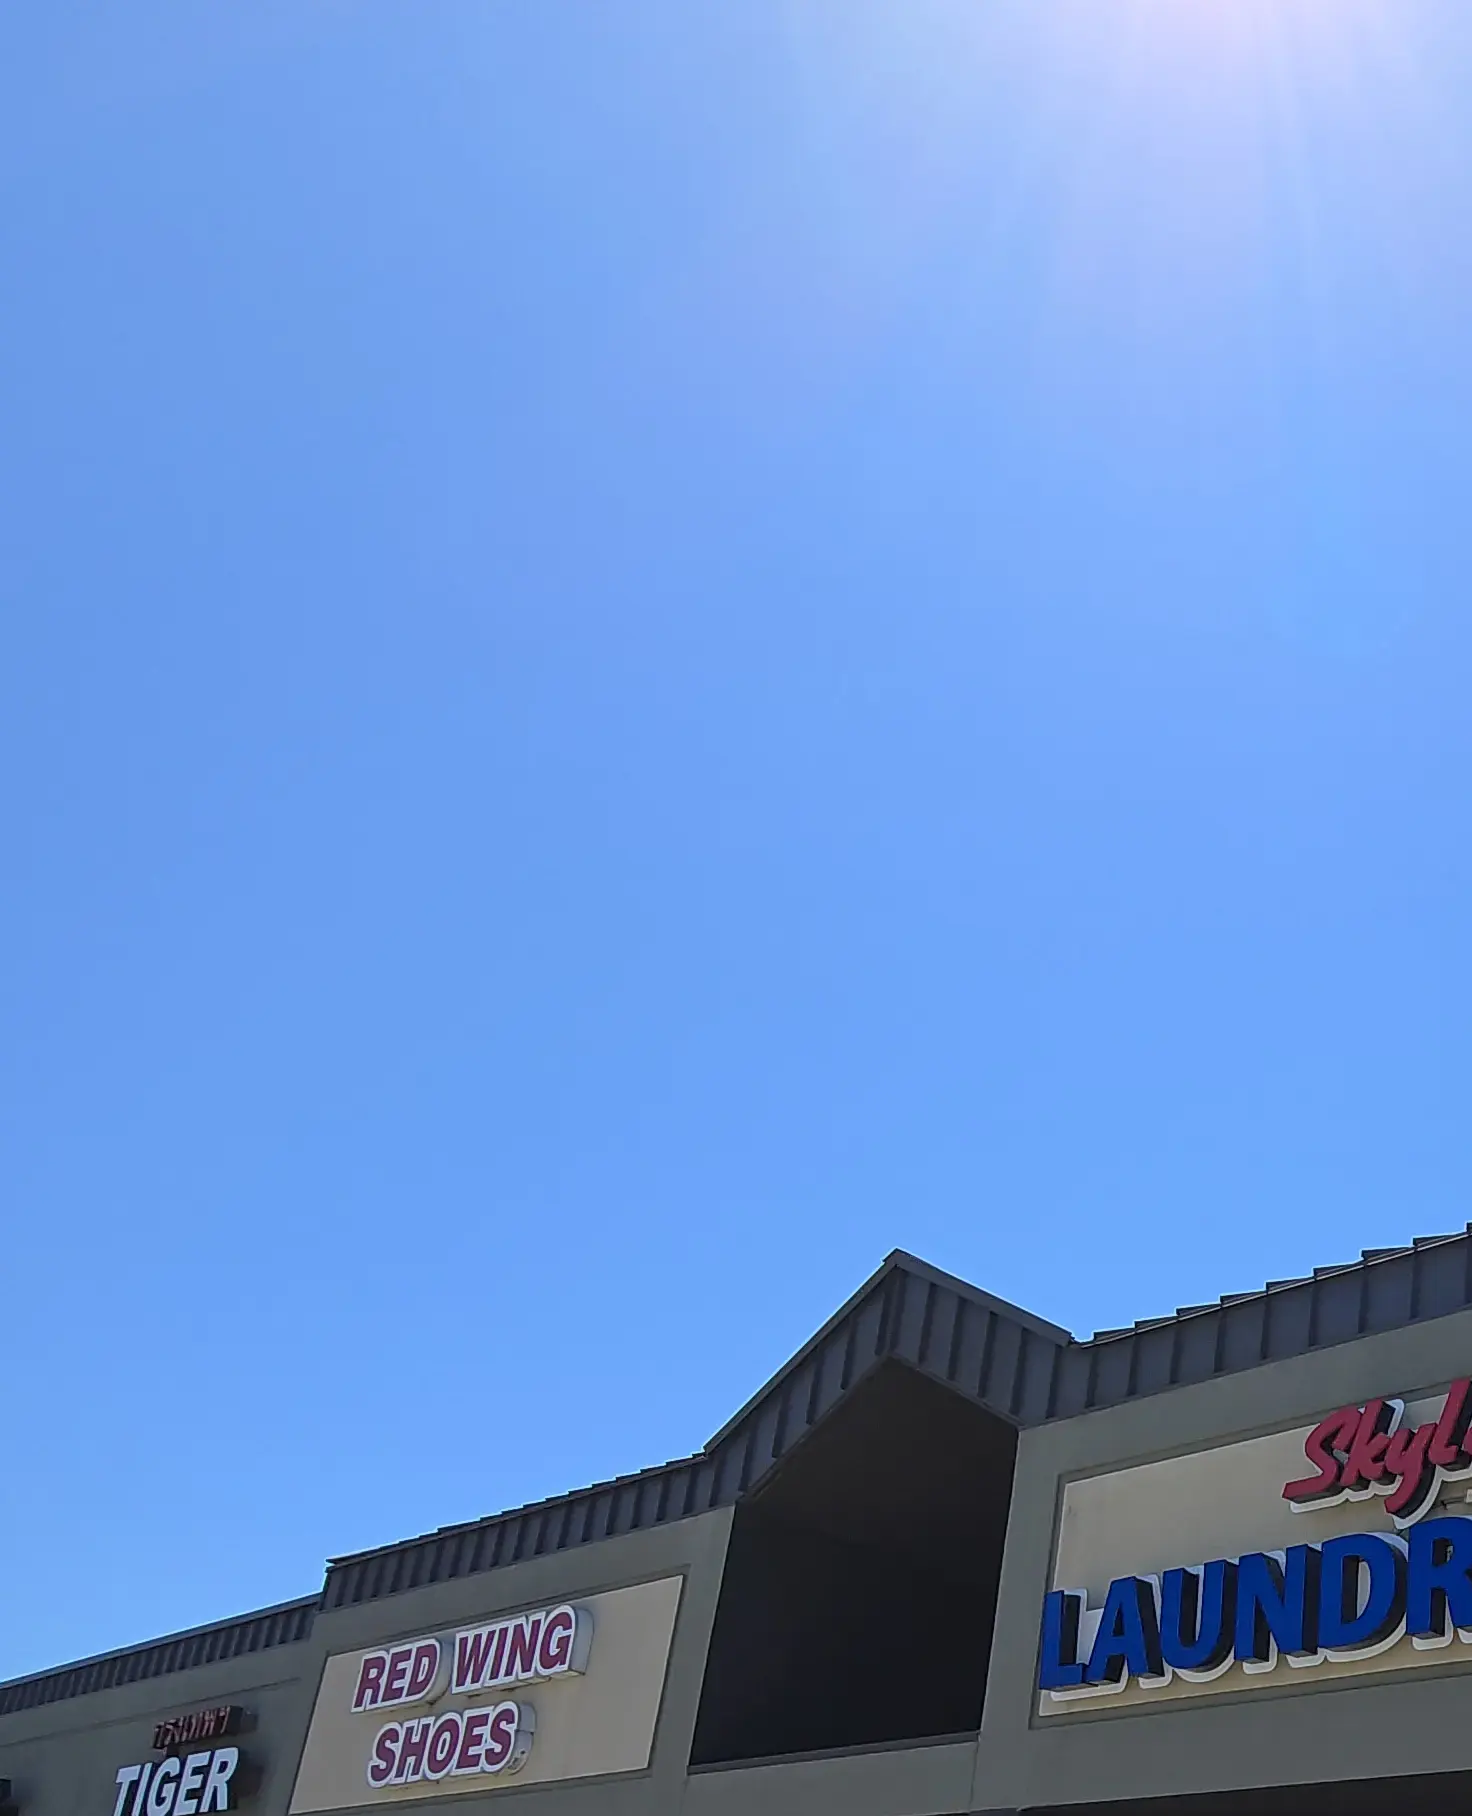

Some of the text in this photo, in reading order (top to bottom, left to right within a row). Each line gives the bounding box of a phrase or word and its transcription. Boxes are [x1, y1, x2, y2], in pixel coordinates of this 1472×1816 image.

[351, 1605, 580, 1713] RED WING
[367, 1701, 521, 1789] SHOES
